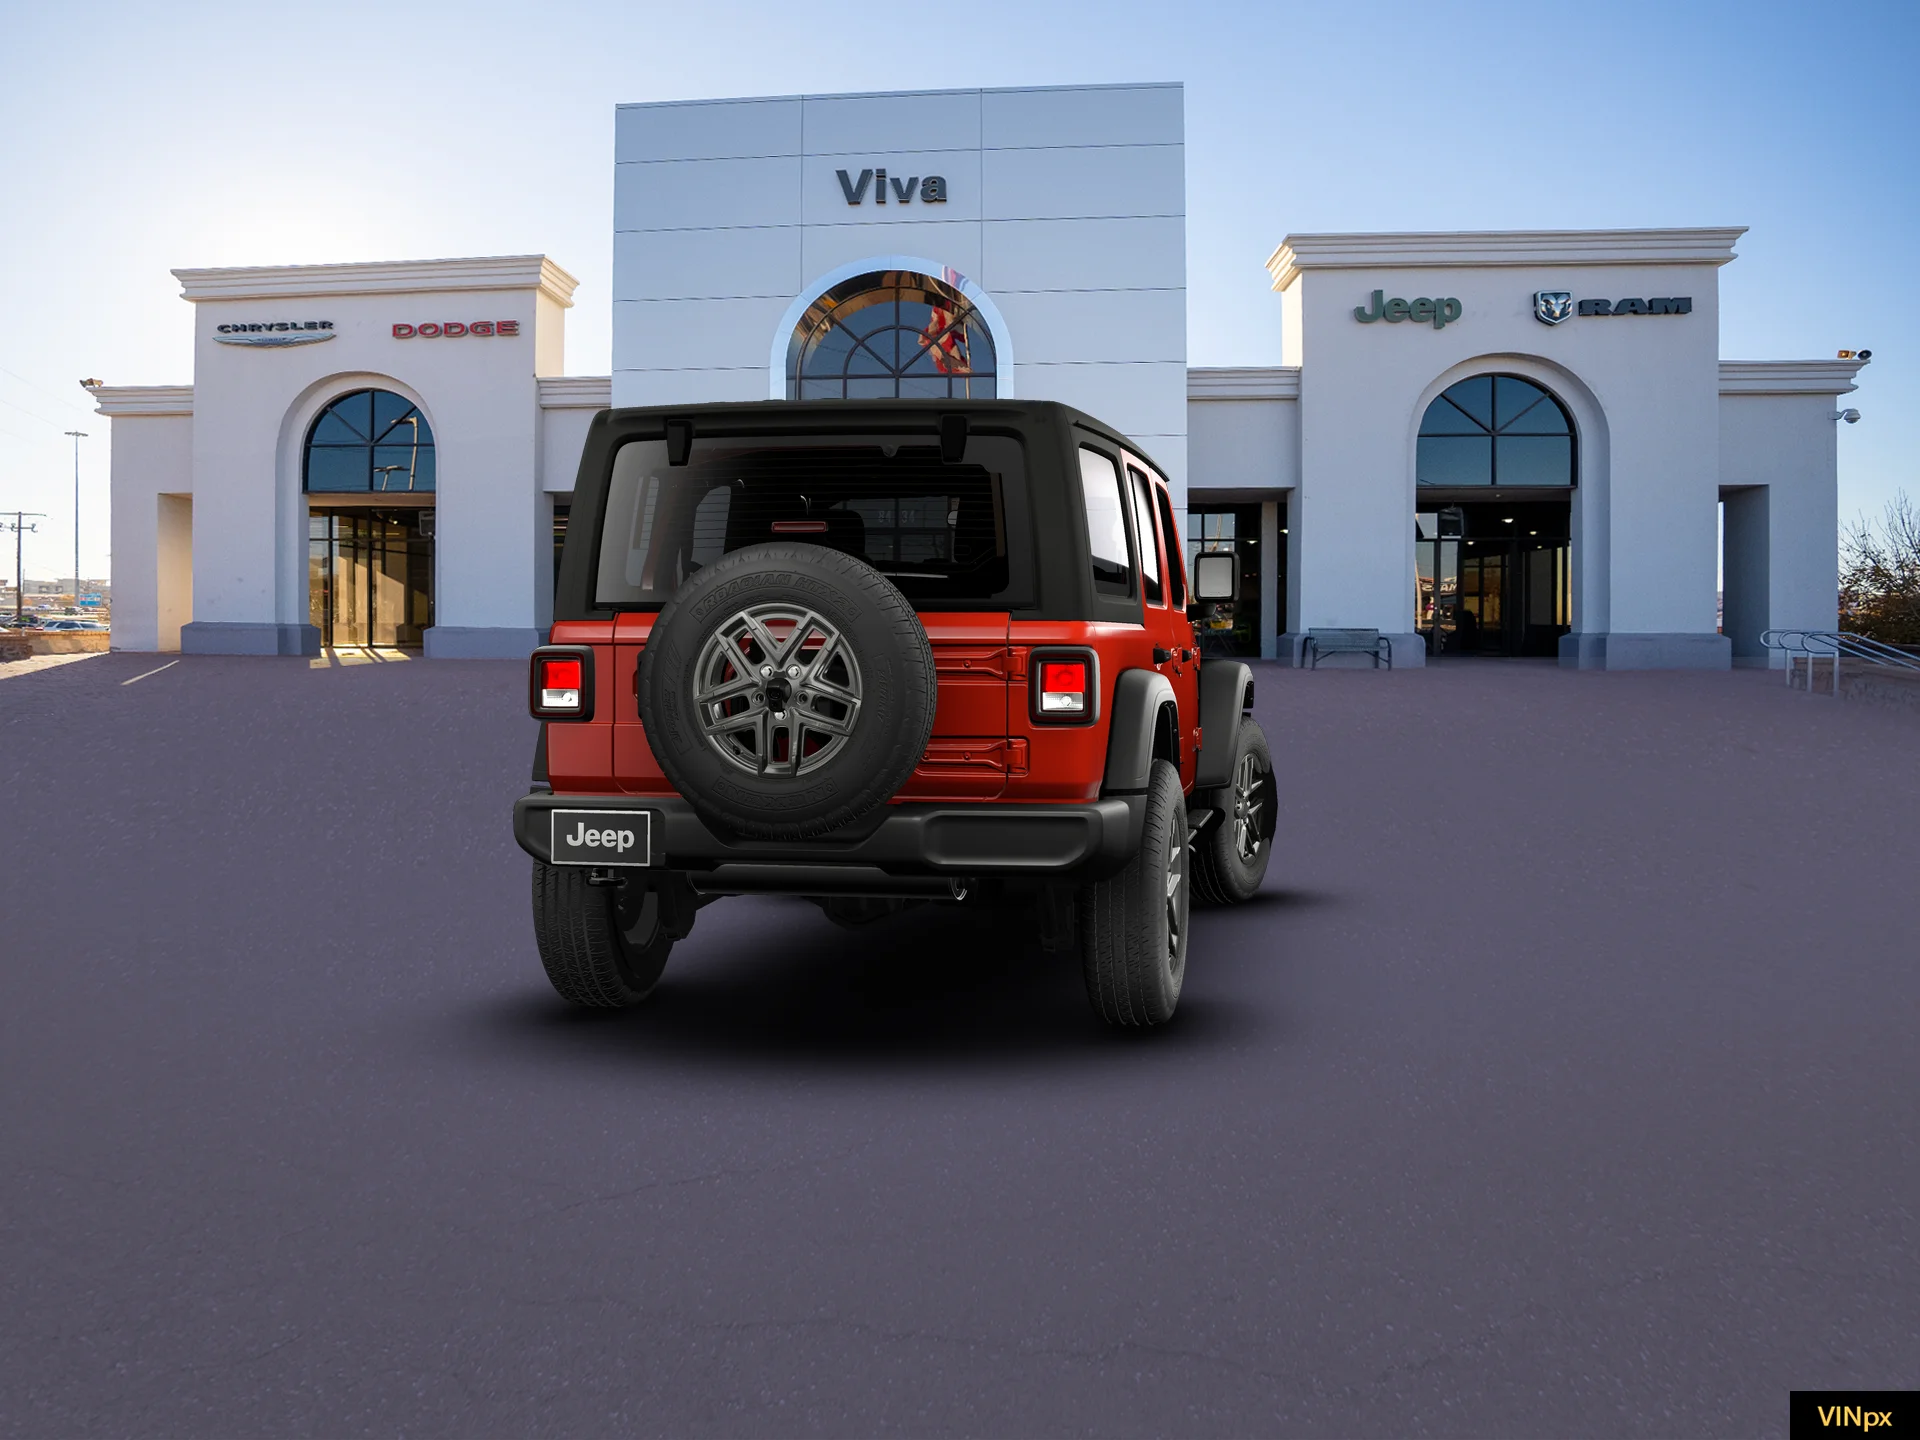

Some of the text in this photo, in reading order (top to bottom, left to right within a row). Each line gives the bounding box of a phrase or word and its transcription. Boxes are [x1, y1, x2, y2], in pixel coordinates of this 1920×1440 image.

[835, 168, 947, 206] Viva
[1354, 289, 1462, 329] Jeep
[1578, 297, 1692, 316] RAM
[216, 320, 333, 333] CHRYSLER
[391, 319, 519, 339] DODGE
[703, 573, 792, 609] ROADIAN
[566, 822, 635, 853] Jeep
